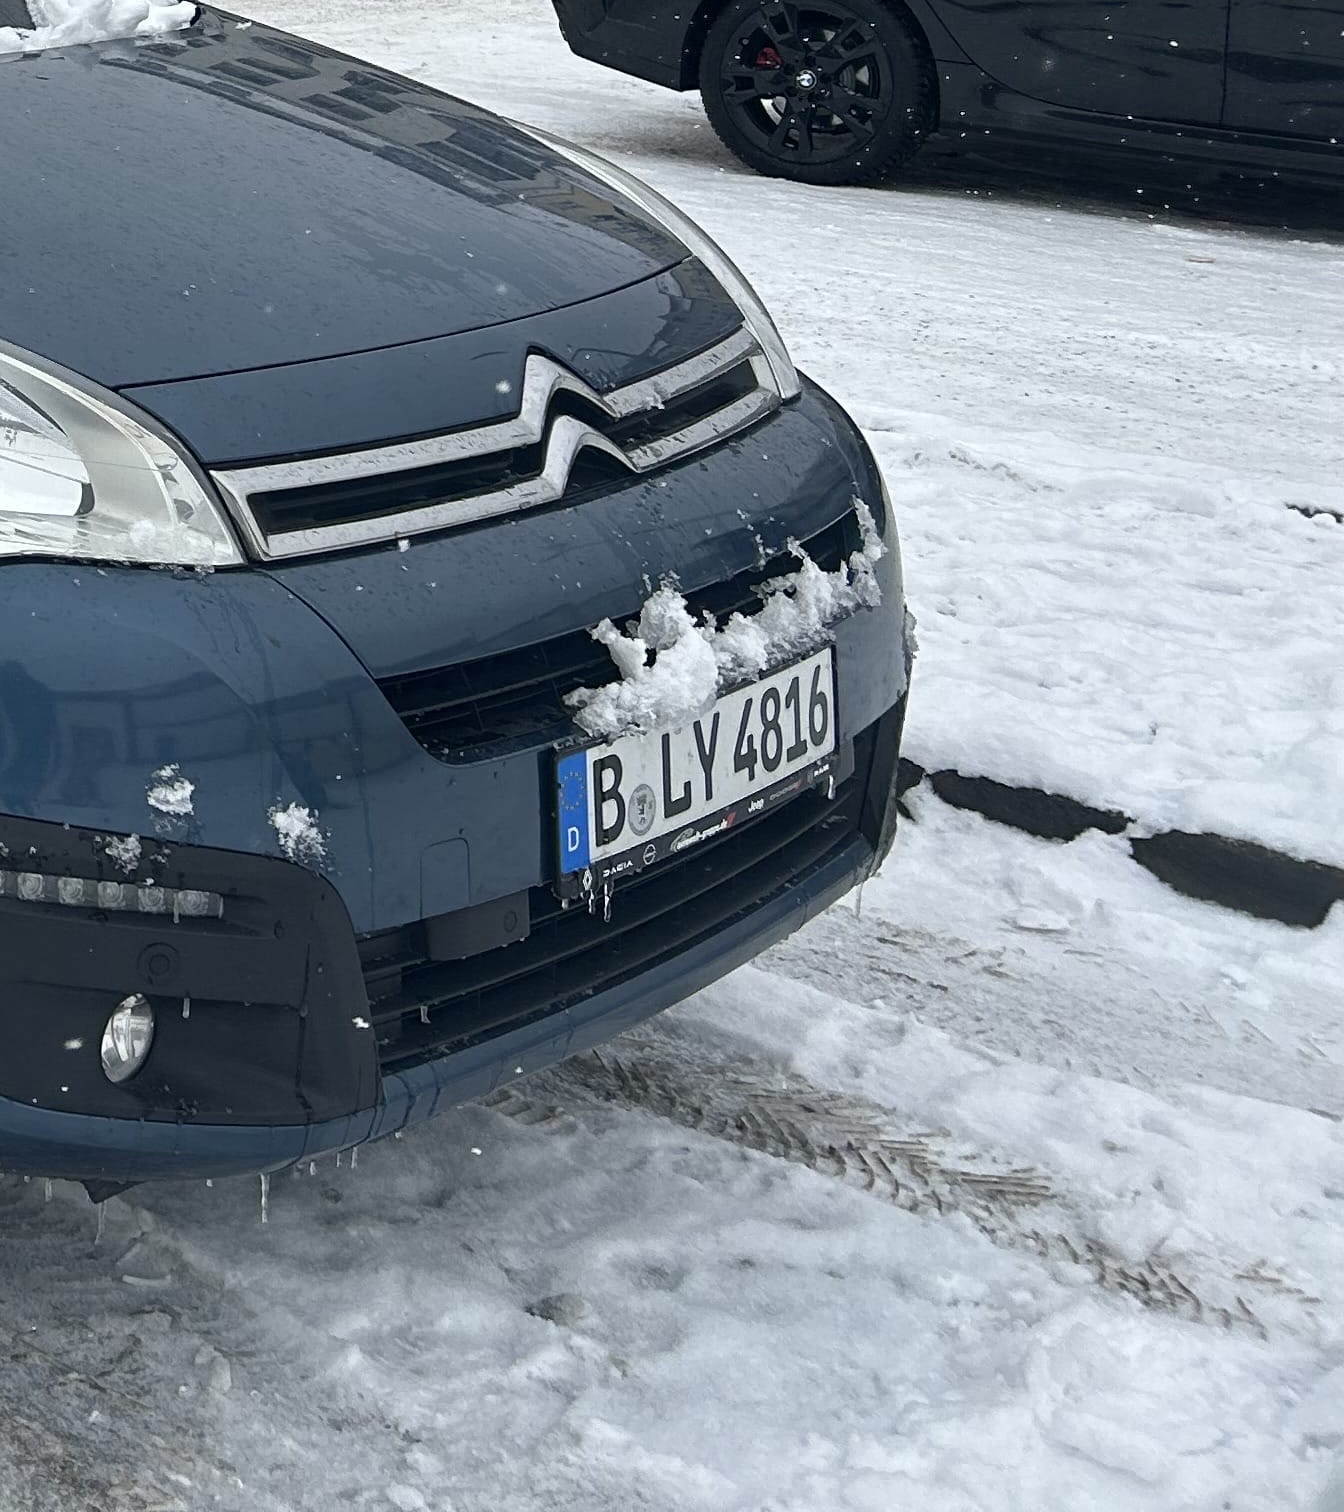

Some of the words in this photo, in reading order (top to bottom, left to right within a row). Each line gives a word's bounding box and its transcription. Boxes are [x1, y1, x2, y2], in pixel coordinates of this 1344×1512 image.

[592, 754, 625, 848] B
[661, 711, 720, 819] LY
[733, 664, 829, 781] 4816
[814, 763, 830, 777] RAM
[747, 797, 764, 814] Jeep
[567, 826, 580, 852] D
[602, 860, 634, 878] DACIA
